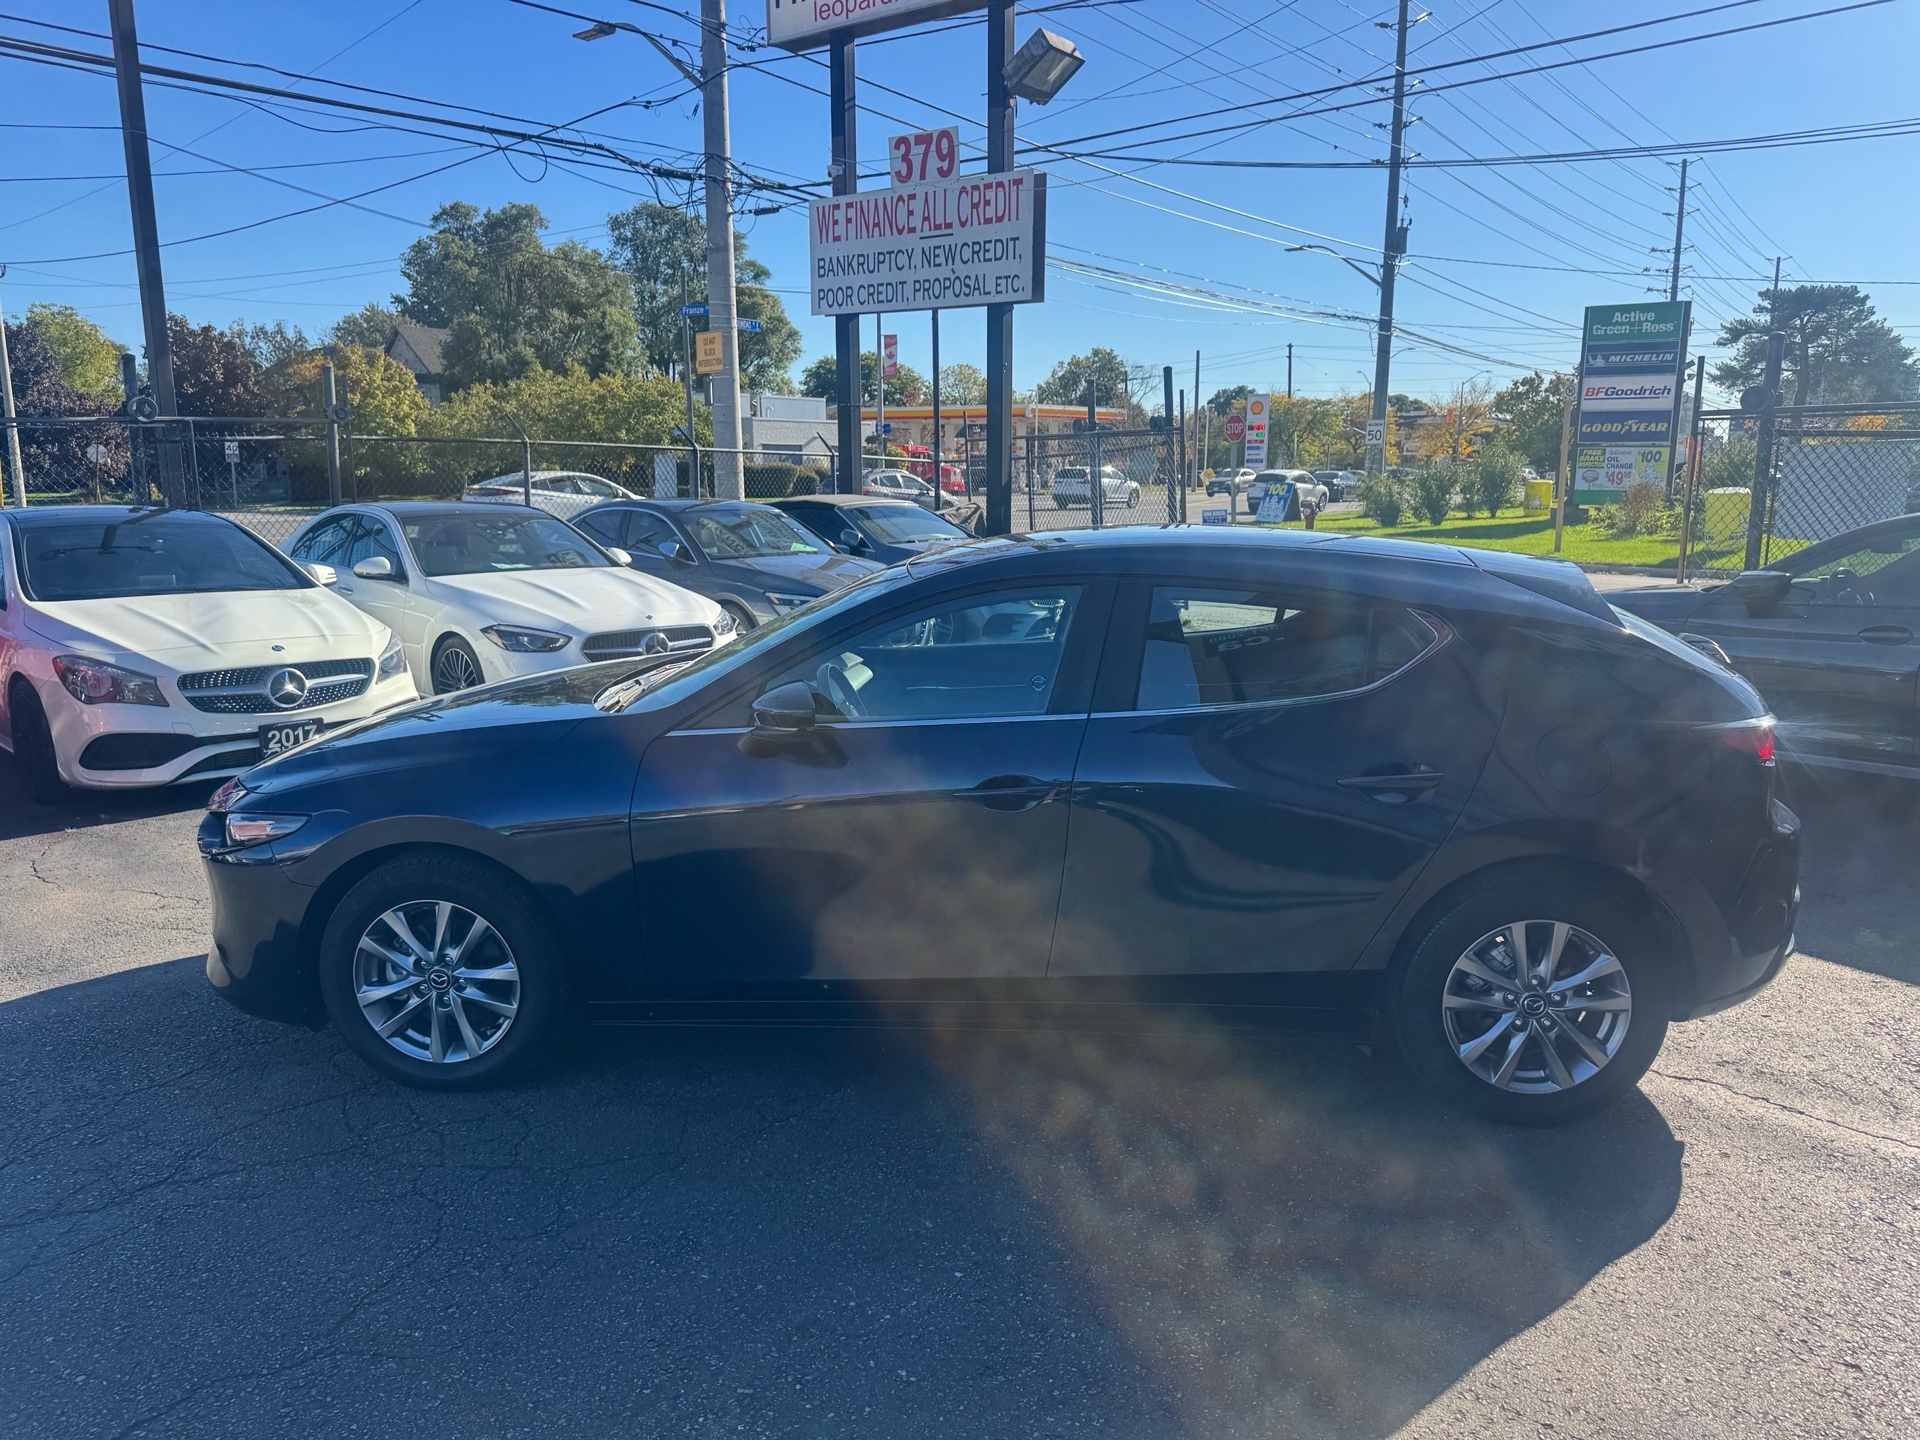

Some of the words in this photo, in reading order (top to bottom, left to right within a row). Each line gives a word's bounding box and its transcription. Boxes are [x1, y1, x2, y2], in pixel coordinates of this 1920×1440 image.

[813, 0, 893, 22] leopa
[893, 129, 956, 184] 379
[816, 203, 842, 244] WE
[845, 192, 917, 242] FINANCE
[920, 188, 954, 233] ALL
[957, 177, 1024, 229] CREDIT
[817, 247, 917, 279] BANKRUPTCY,
[921, 243, 957, 269] NEW
[959, 237, 1023, 265] CREDIT,
[818, 286, 854, 309] POOR
[857, 280, 909, 306] CREDIT,
[995, 273, 1025, 295] ETC.
[682, 306, 704, 315] Franze
[1612, 310, 1656, 323] Active
[704, 347, 716, 357] BLOCK
[1608, 353, 1675, 363] MICHELIN
[1584, 385, 1672, 397] BFGoodrich
[1226, 423, 1244, 434] STOP
[1367, 430, 1382, 441] 50
[267, 724, 317, 748] 2017
